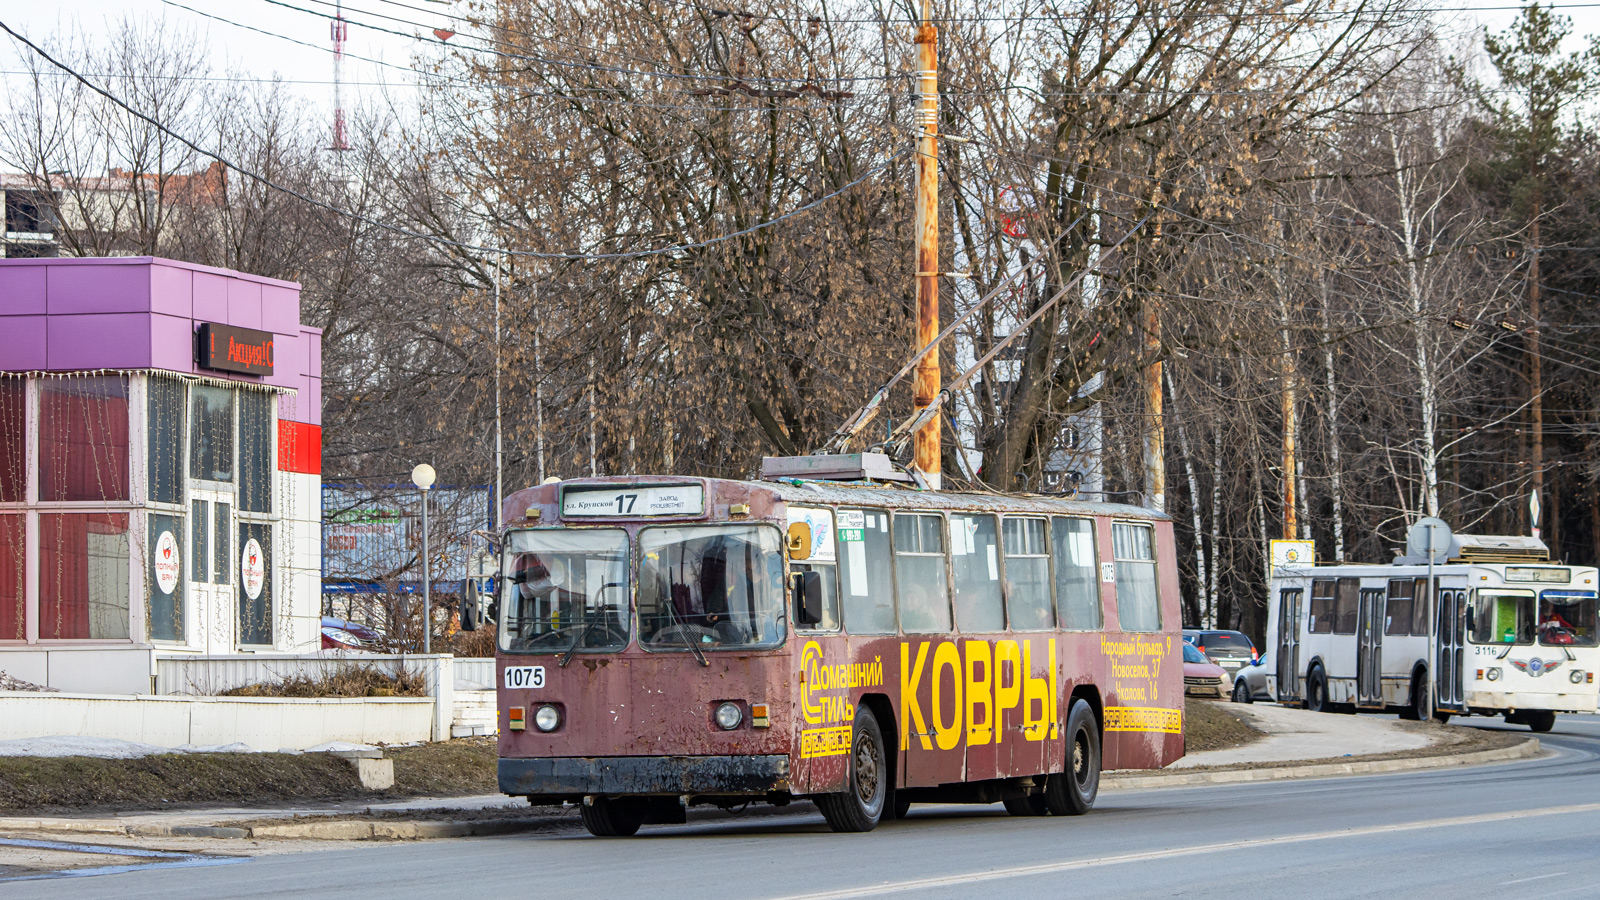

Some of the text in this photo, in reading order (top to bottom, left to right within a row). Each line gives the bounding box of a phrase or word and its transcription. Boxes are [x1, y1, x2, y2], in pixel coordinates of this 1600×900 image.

[566, 501, 613, 510] ул. Крупской
[615, 494, 638, 513] 17
[1102, 564, 1114, 580] 1075
[1532, 571, 1540, 581] 12
[1101, 635, 1171, 662] Народный бульвар, 9
[506, 668, 543, 686] 1075
[809, 655, 883, 696] Домашний
[1112, 658, 1161, 681] Новоселов, 37
[901, 639, 1058, 751] КОВРЫ
[1115, 681, 1158, 704] Чкалова, 16
